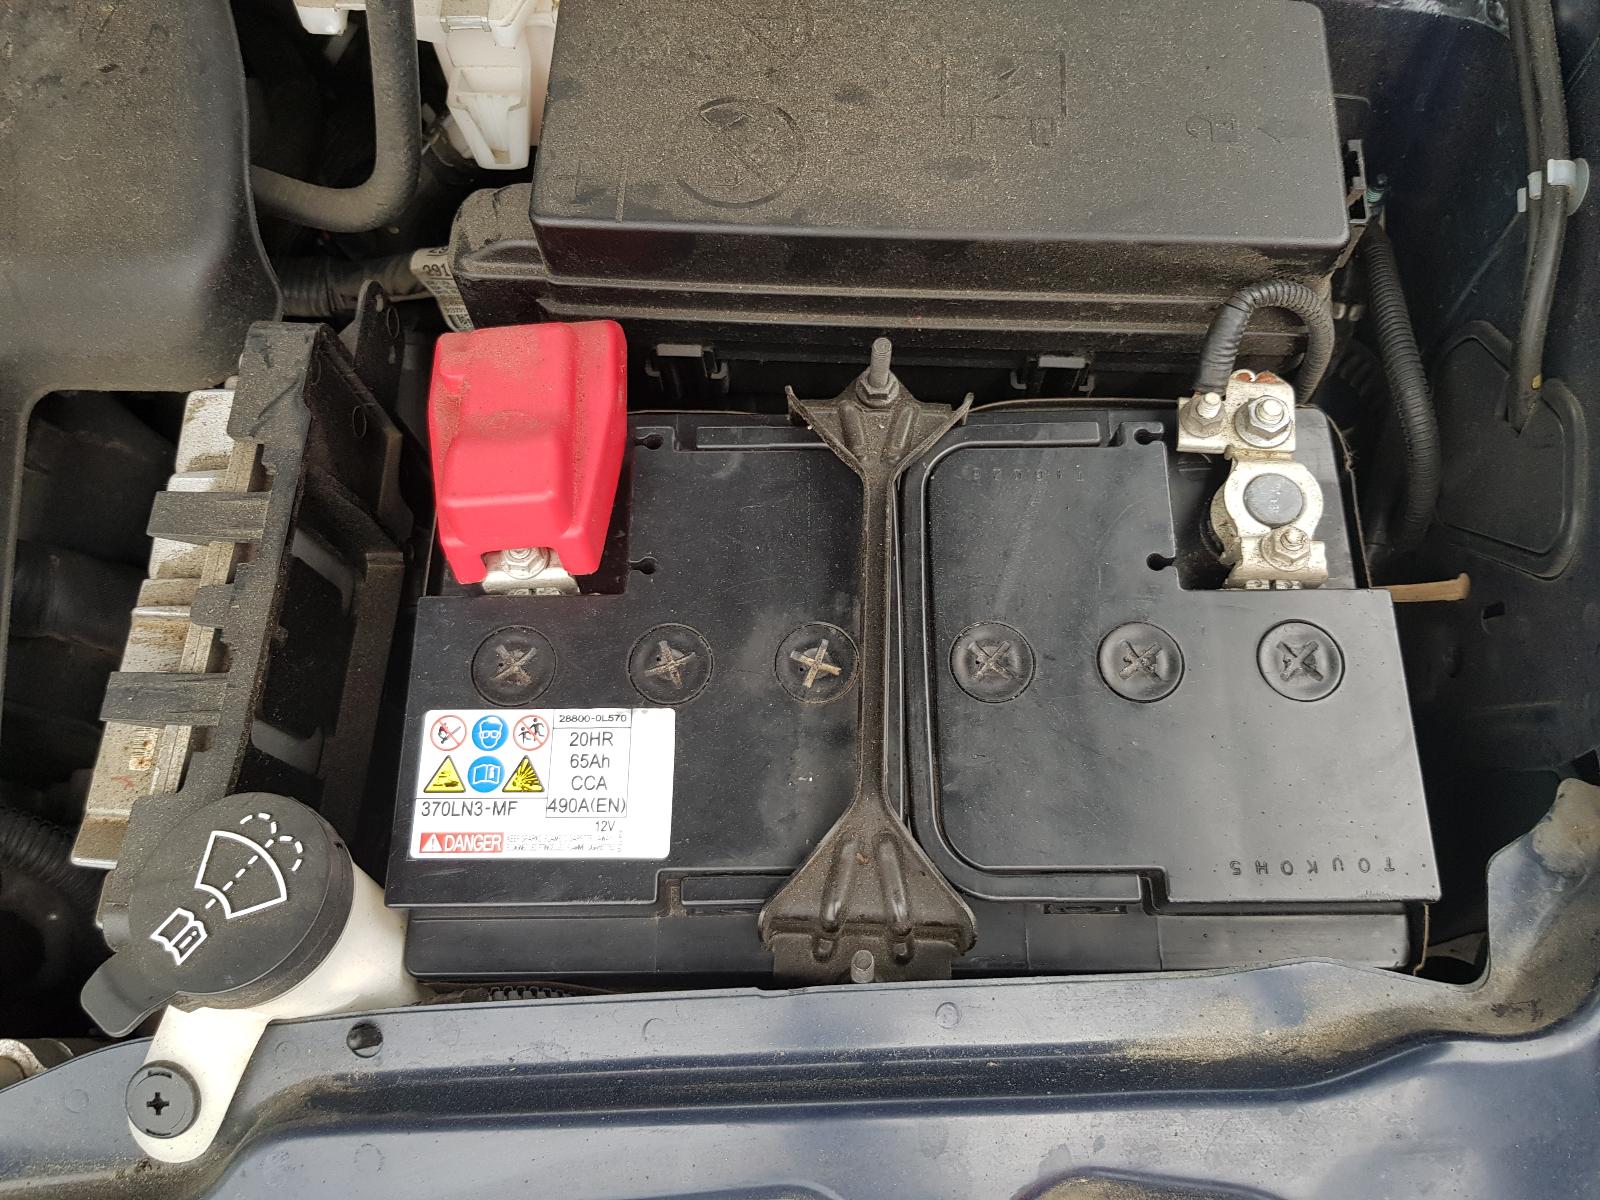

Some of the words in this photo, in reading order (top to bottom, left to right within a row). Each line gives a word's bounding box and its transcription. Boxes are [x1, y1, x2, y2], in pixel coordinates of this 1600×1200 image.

[559, 714, 627, 723] 28800-0L570
[569, 731, 614, 747] 20HR
[570, 753, 610, 769] 65Ah
[571, 775, 608, 791] CCA
[421, 801, 518, 817] 370LN3-MF
[547, 797, 626, 813] 490A(EN)
[595, 820, 616, 832] 12V
[444, 833, 503, 852] DANGER
